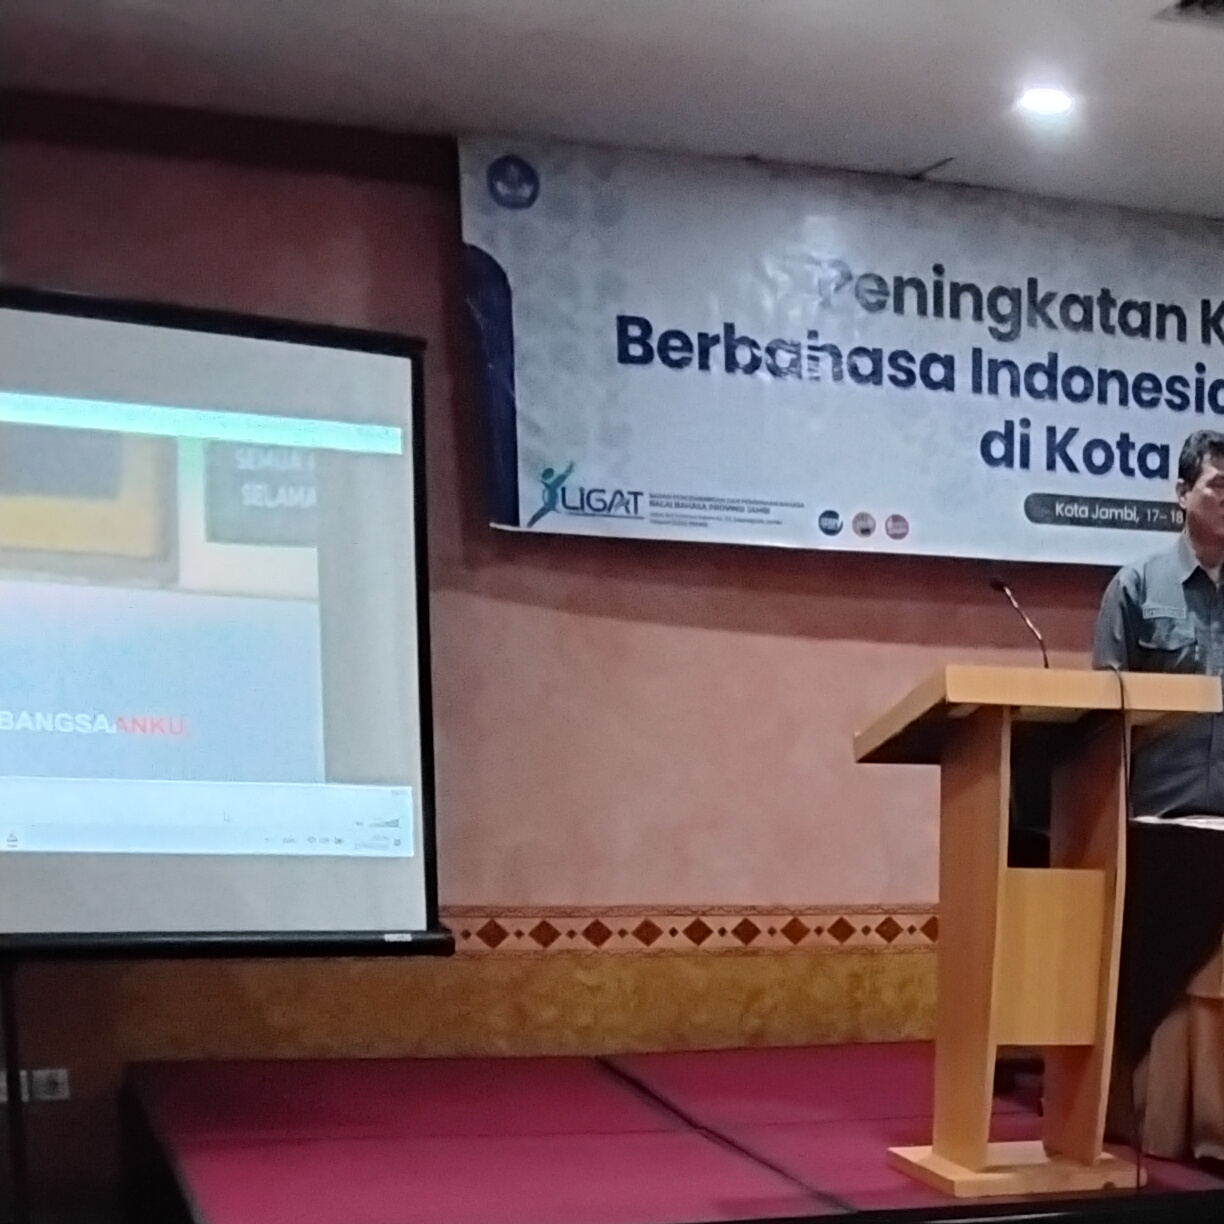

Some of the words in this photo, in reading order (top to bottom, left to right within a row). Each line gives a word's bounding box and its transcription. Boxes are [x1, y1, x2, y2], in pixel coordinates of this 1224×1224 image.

[615, 314, 956, 392] Berbahasa
[979, 418, 1031, 470] di
[1045, 425, 1170, 480] Kota
[561, 486, 645, 516] LIGAT
[1055, 502, 1089, 519] Kota
[1091, 503, 1140, 523] Jambi,
